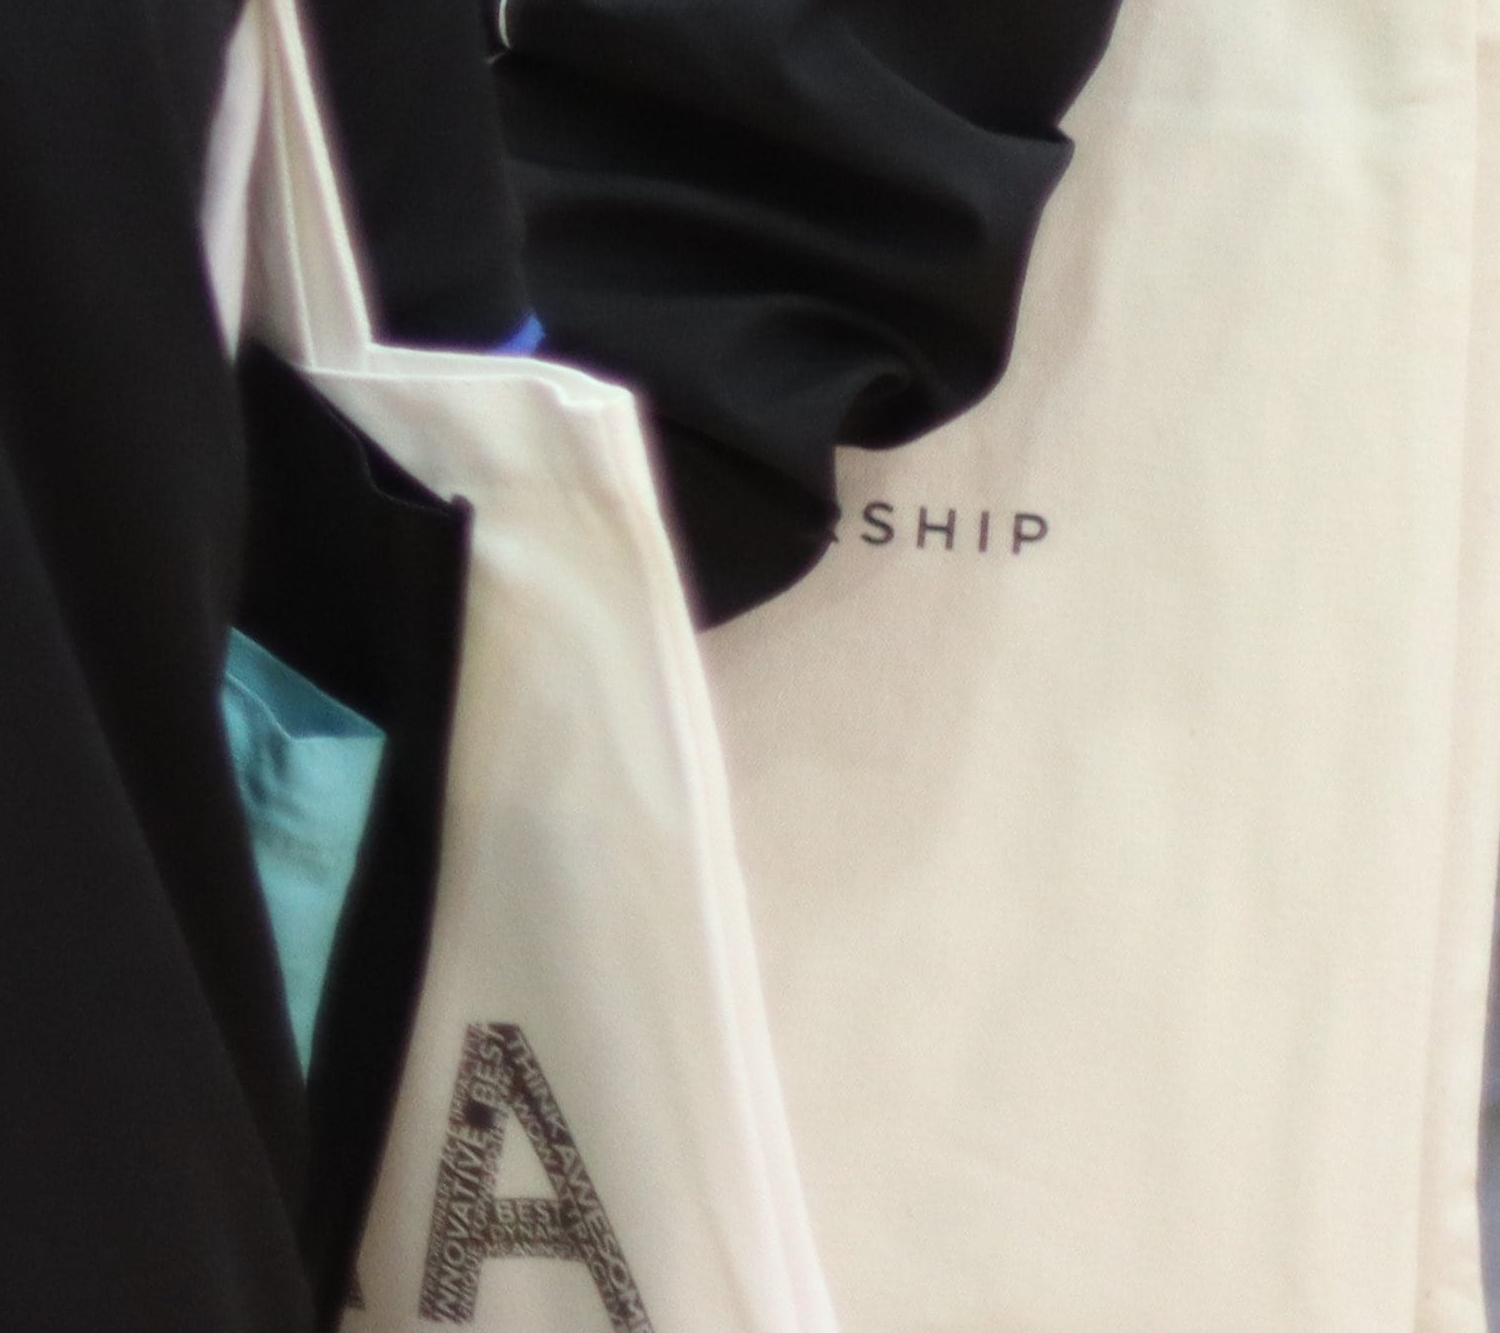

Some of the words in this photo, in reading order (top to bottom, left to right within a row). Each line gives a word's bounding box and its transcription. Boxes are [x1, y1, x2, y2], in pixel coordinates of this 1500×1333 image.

[830, 500, 1050, 556] SHIP
[469, 1023, 508, 1103] BEST
[506, 1031, 568, 1141] THINK
[434, 1127, 489, 1321] INNOVATIVE
